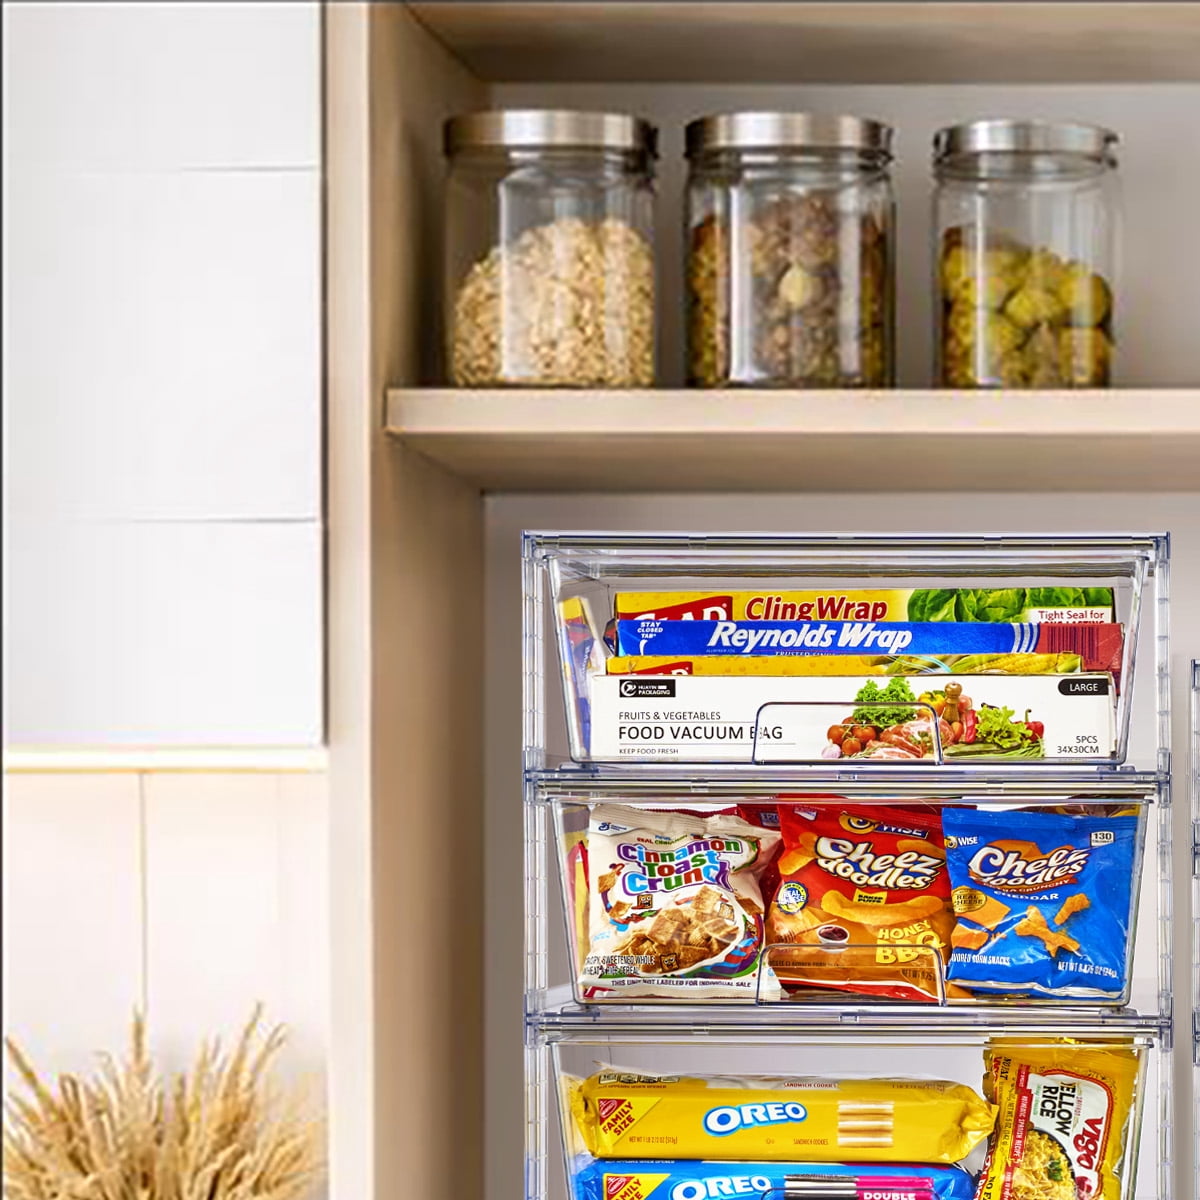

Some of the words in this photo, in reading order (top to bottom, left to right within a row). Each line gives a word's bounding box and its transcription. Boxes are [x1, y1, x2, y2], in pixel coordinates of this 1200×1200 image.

[746, 597, 815, 620] Cling
[817, 597, 887, 620] Wrap
[1038, 610, 1064, 622] Tight
[1066, 610, 1087, 620] Seal
[1090, 610, 1105, 620] for
[707, 622, 837, 654] Reynolds
[837, 622, 912, 655] Wrap
[1069, 683, 1099, 692] LARGE
[618, 711, 651, 720] FRUITS
[653, 711, 661, 720] &
[663, 711, 721, 720] VEGETABLES
[618, 726, 664, 740] FOOD
[670, 726, 744, 740] VACUUM
[1076, 735, 1098, 744] 5PCS
[1057, 745, 1099, 754] 34X30CM
[958, 836, 978, 846] WISE
[1093, 832, 1113, 841] 130
[622, 840, 741, 863] Cinnamon
[816, 836, 943, 875] Cheez
[643, 850, 720, 877] Toast
[968, 846, 1090, 877] Cheez
[1019, 878, 1070, 893] CRUNCHY
[994, 890, 1059, 901] CHEDDAR
[878, 920, 932, 939] HONEY
[876, 931, 946, 964] BBQ
[636, 954, 655, 966] WHOLE
[1039, 1085, 1059, 1119] RICE
[602, 1102, 634, 1134] FAMILY
[613, 1114, 635, 1136] SIZE
[706, 1103, 806, 1132] OREO
[1017, 1119, 1026, 1138] SPANISH
[1013, 1139, 1023, 1158] RECIPE
[1073, 1117, 1104, 1170] Vigo
[985, 1176, 996, 1189] NO
[863, 1192, 916, 1200] DOUBLE
